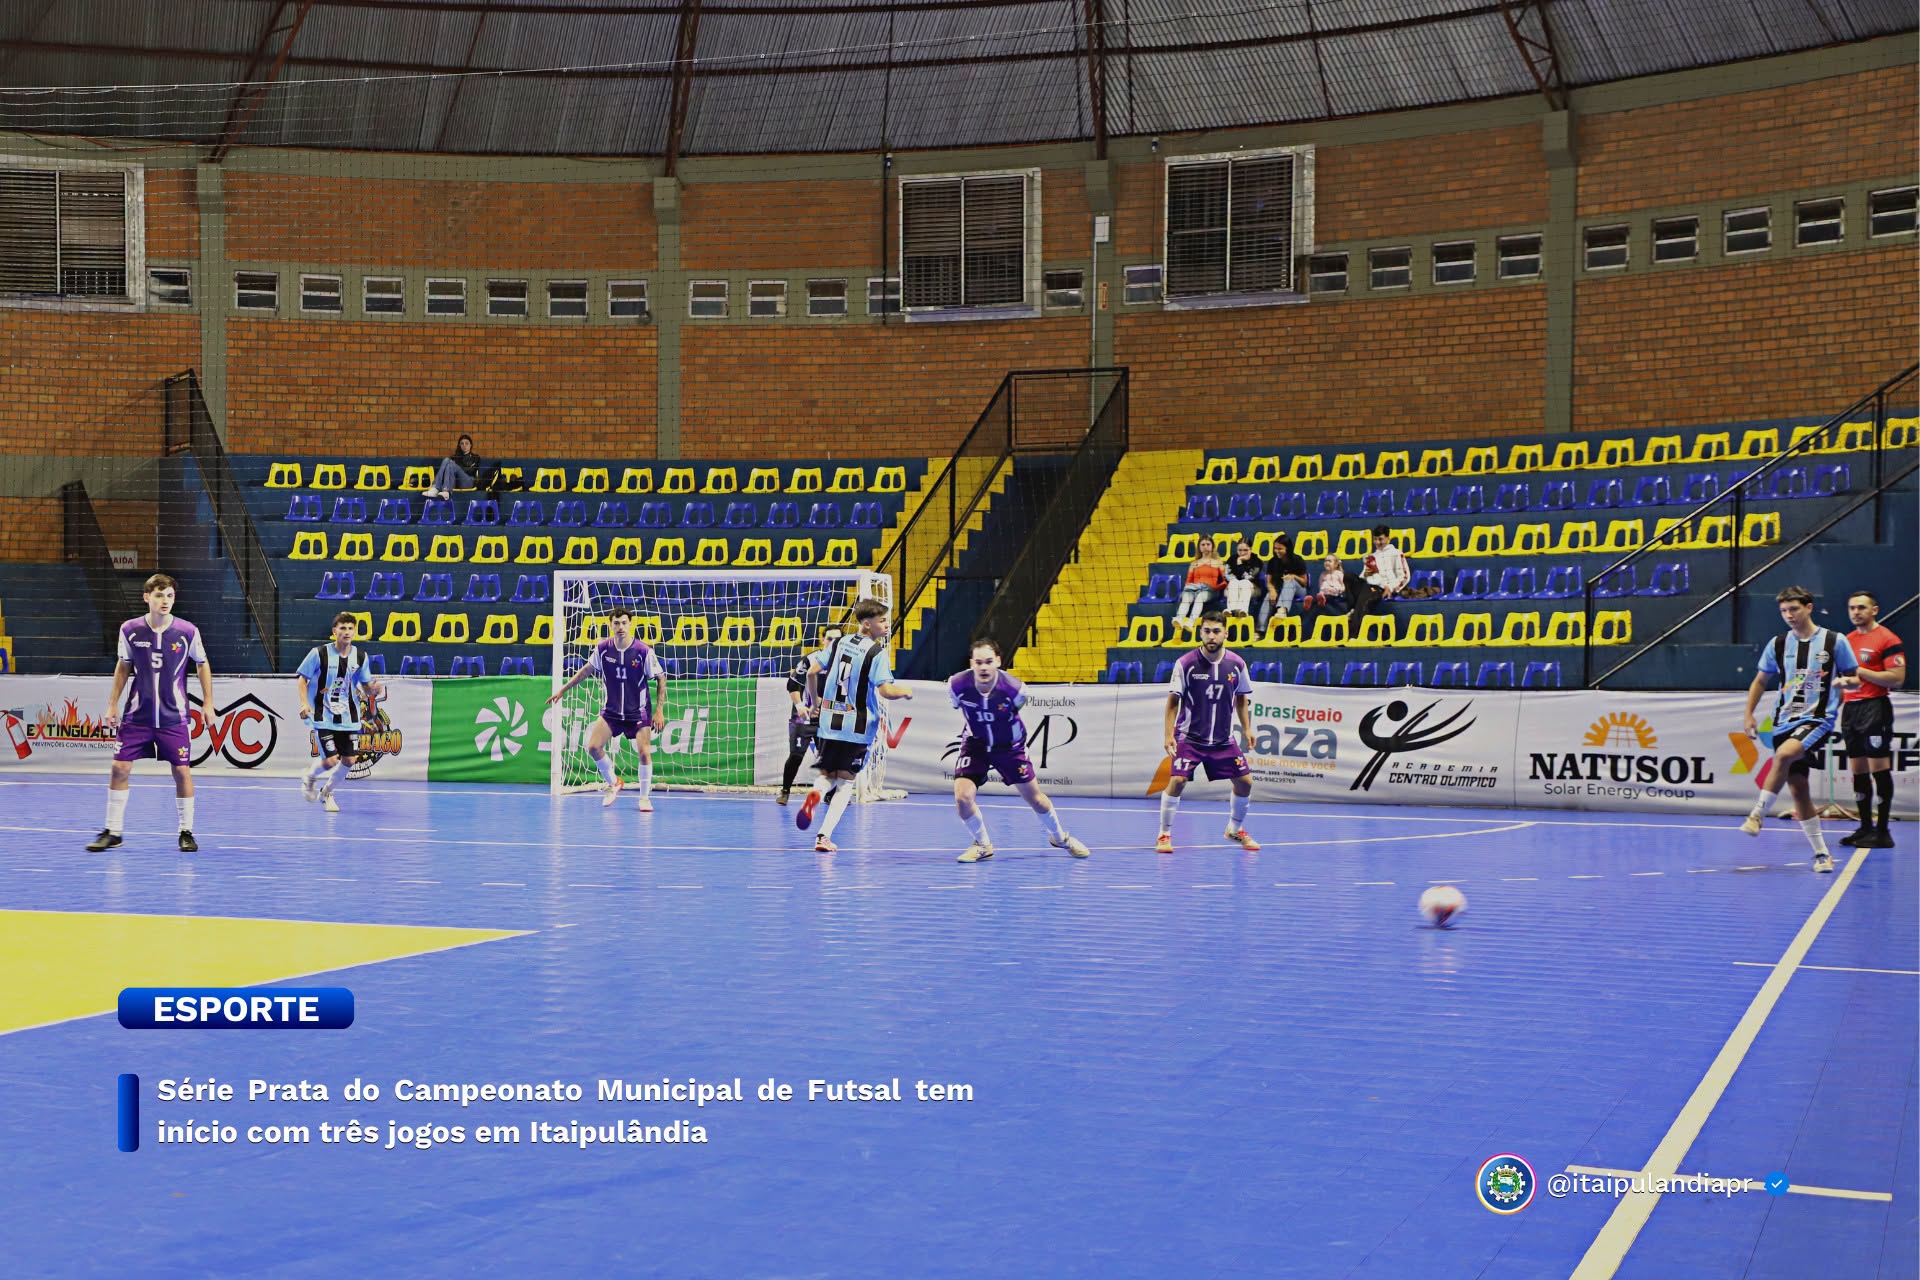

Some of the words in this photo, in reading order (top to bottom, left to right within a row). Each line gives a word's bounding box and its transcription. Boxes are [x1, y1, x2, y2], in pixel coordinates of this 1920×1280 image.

[151, 652, 163, 669] 5
[615, 666, 628, 680] 11
[1205, 684, 1224, 700] 47
[1025, 696, 1076, 711] Planejados
[976, 711, 995, 722] 10
[1254, 703, 1343, 723] Brasiguaio
[957, 757, 971, 769] 10
[1174, 757, 1192, 771] 47
[1392, 761, 1498, 773] ACADEMIA
[1529, 753, 1714, 784] NATUSOL
[1389, 772, 1437, 786] CENTRO
[1544, 783, 1582, 795] Solar
[1587, 783, 1642, 800] Energy
[1646, 786, 1695, 801] Group
